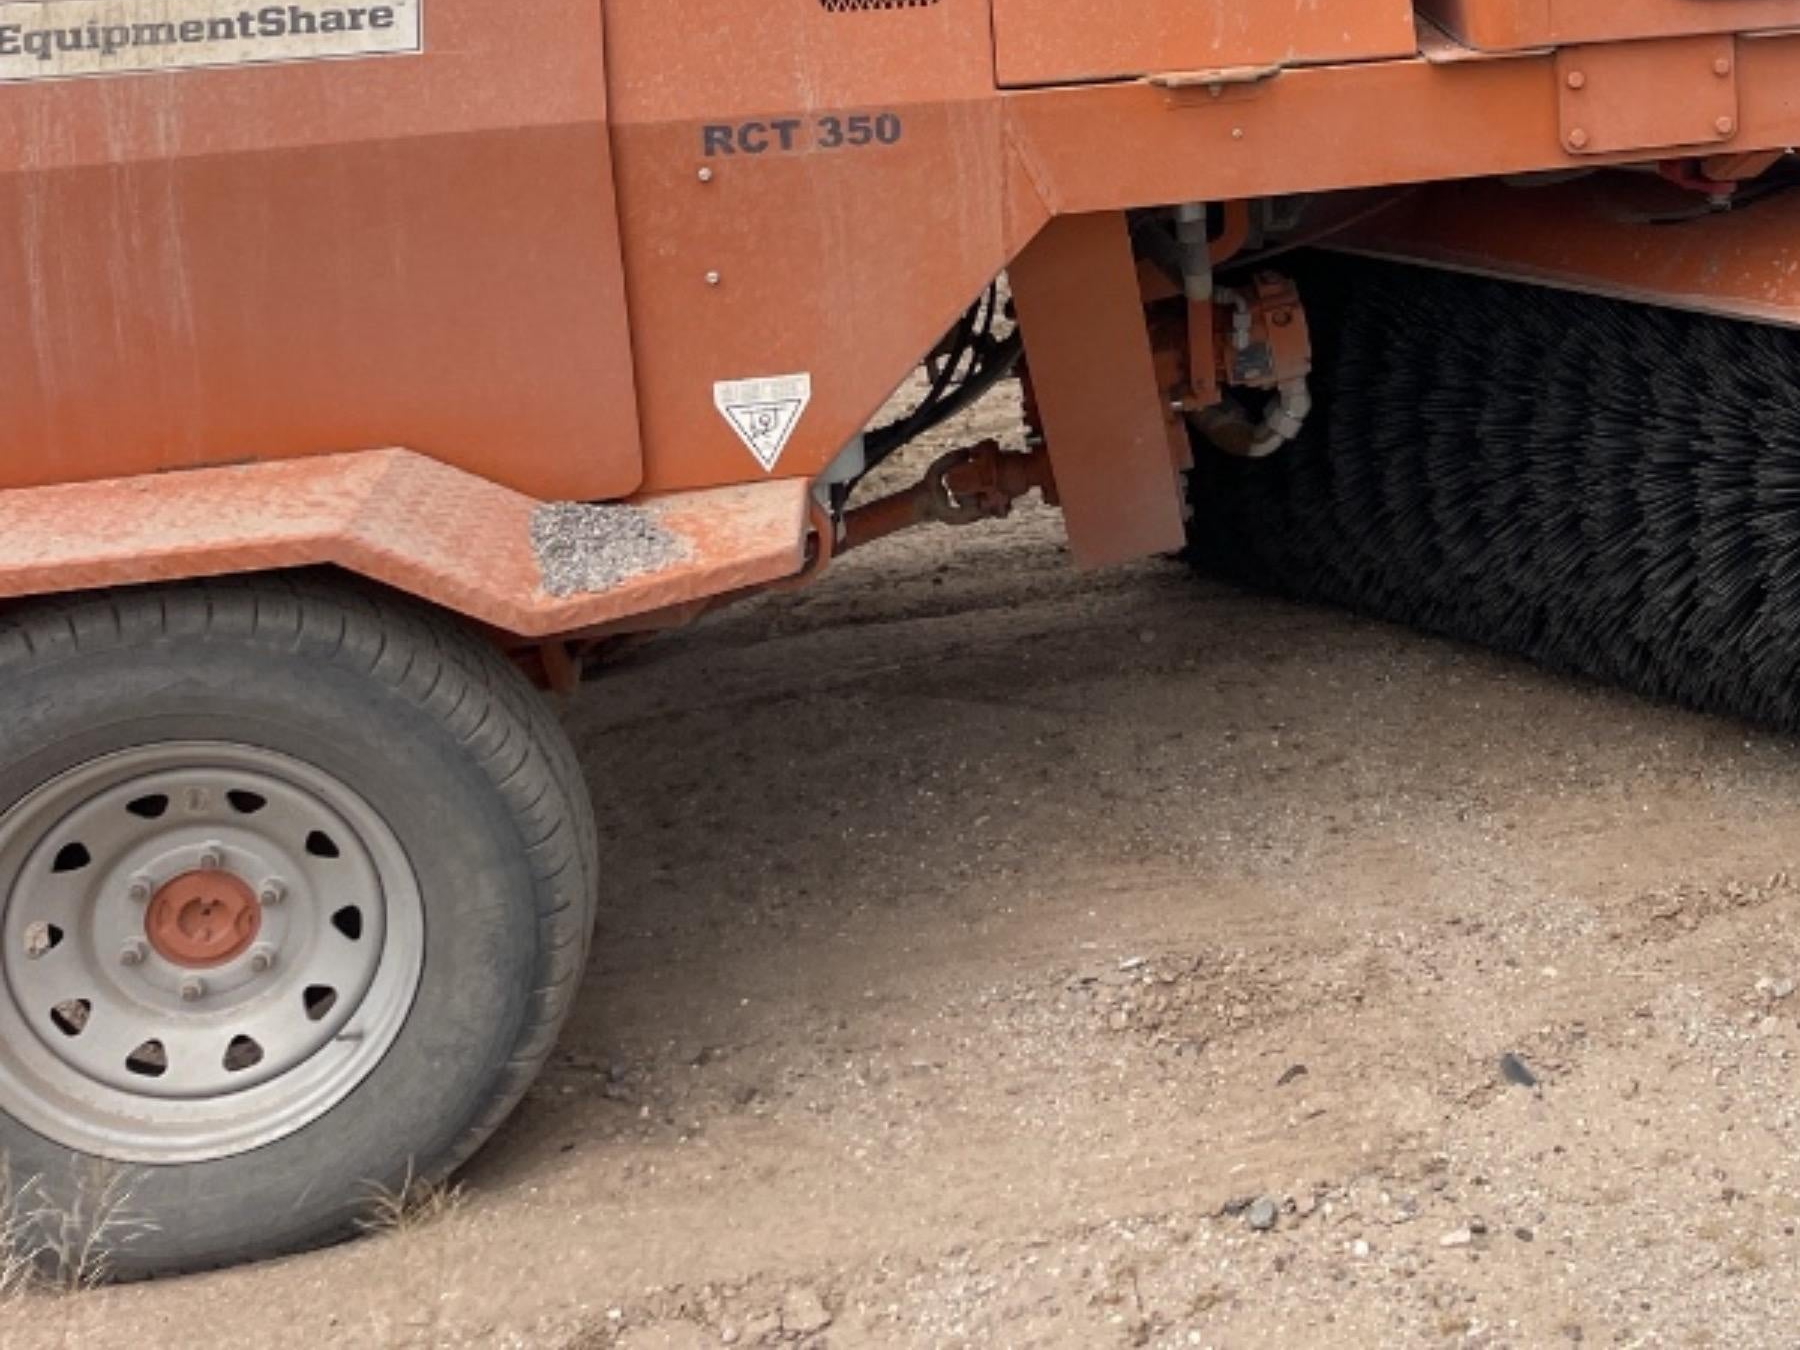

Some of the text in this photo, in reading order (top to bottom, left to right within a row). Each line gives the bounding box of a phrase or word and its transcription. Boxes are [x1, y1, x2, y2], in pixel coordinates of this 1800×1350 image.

[0, 4, 395, 61] EquipmentShare
[703, 113, 902, 156] RCT 350
